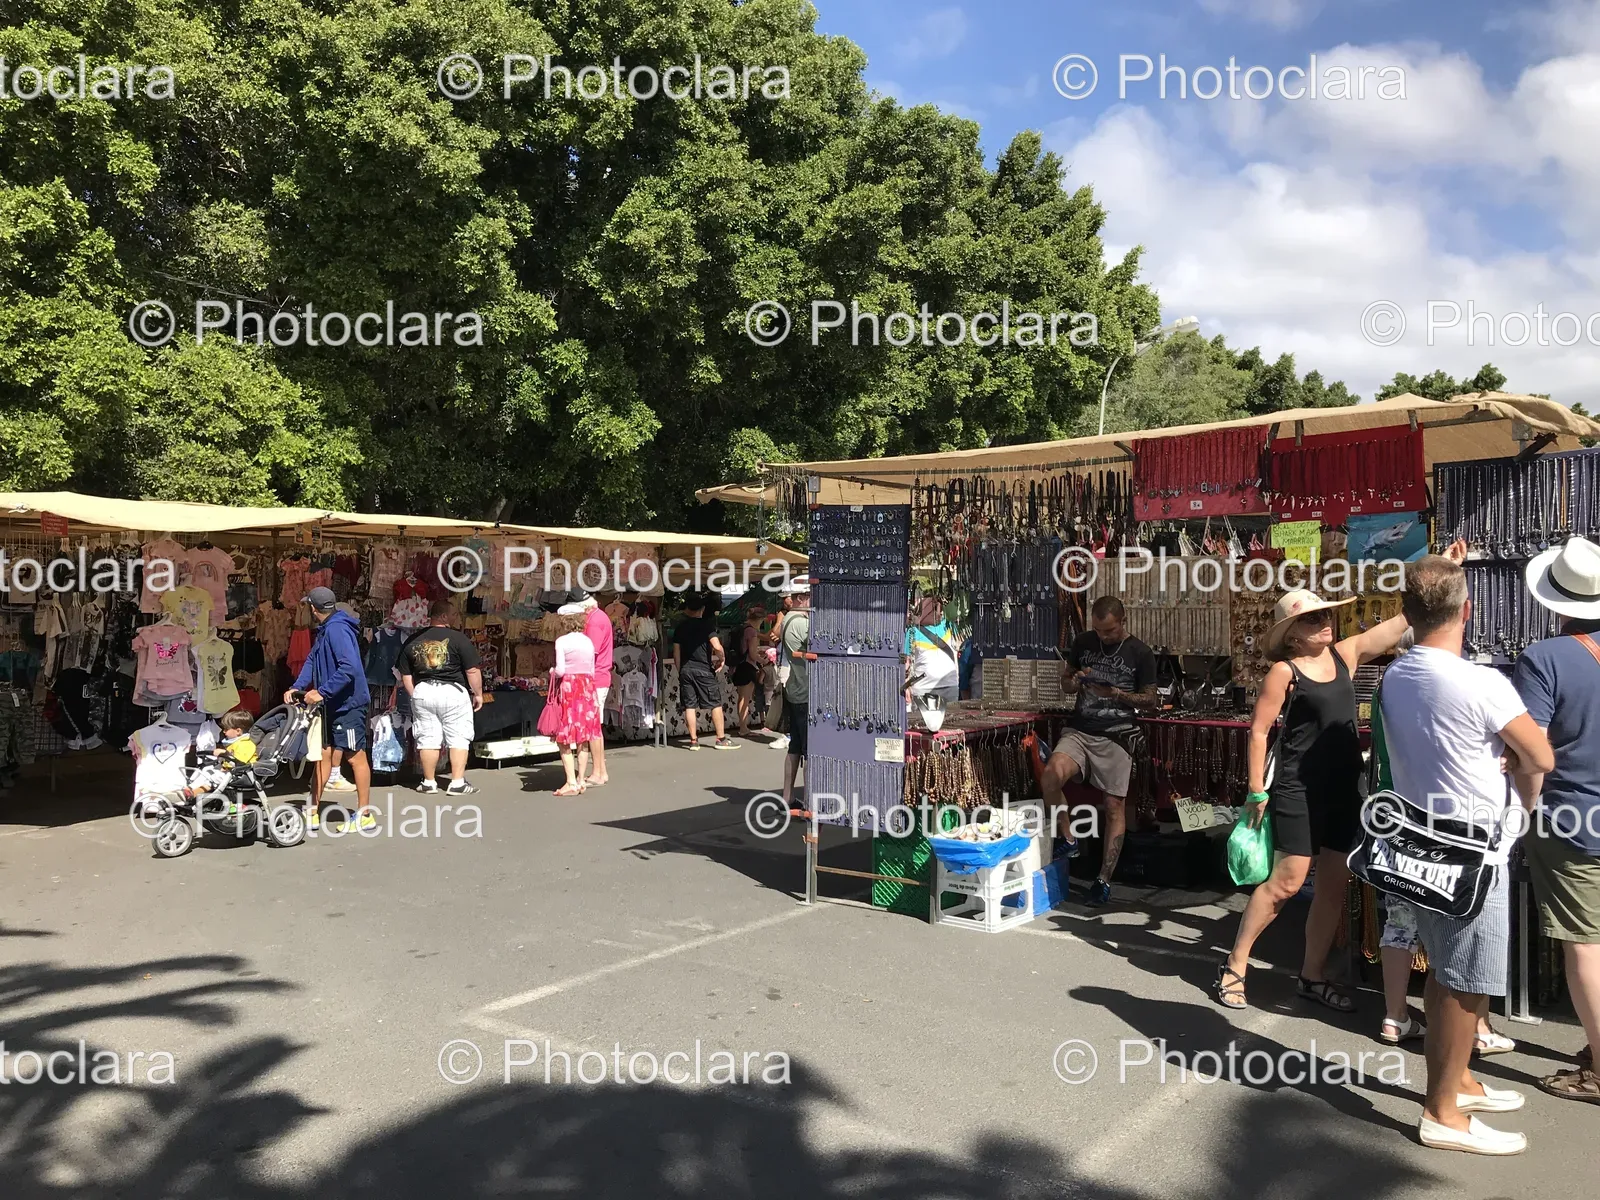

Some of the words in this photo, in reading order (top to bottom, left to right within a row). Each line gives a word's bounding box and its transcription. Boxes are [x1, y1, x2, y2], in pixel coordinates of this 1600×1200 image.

[1274, 530, 1296, 538] SHARK
[1183, 804, 1207, 814] WOOD
[1387, 835, 1406, 848] The
[1406, 840, 1428, 857] City
[1370, 837, 1464, 895] FRANKFURT
[1383, 875, 1426, 897] ORIGINAL
